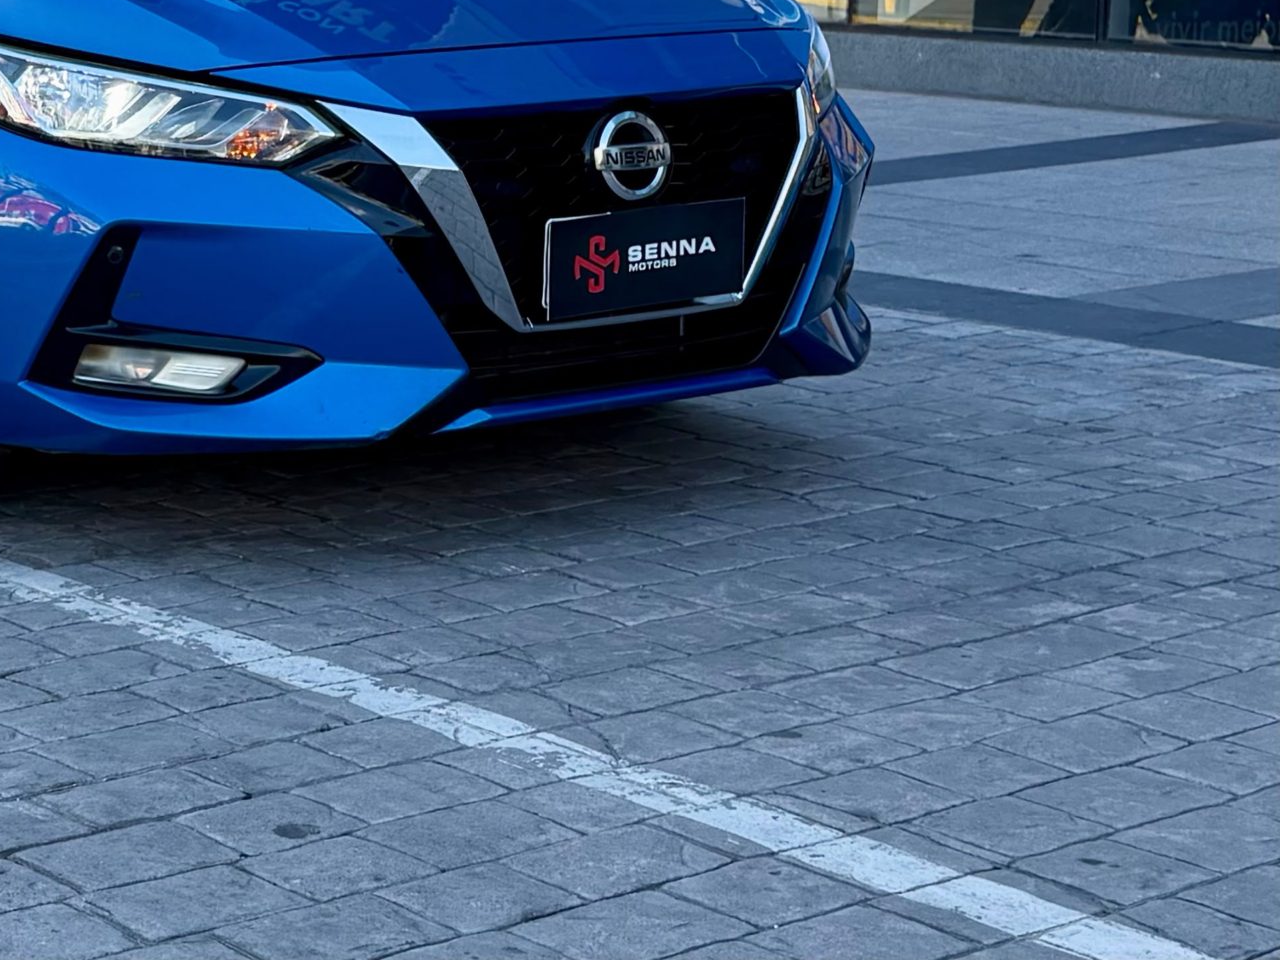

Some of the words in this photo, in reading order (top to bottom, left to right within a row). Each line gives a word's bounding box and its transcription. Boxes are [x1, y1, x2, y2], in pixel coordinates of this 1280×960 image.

[605, 147, 667, 167] NISSAN
[627, 236, 716, 262] SENNA
[628, 257, 677, 273] MOTORS
